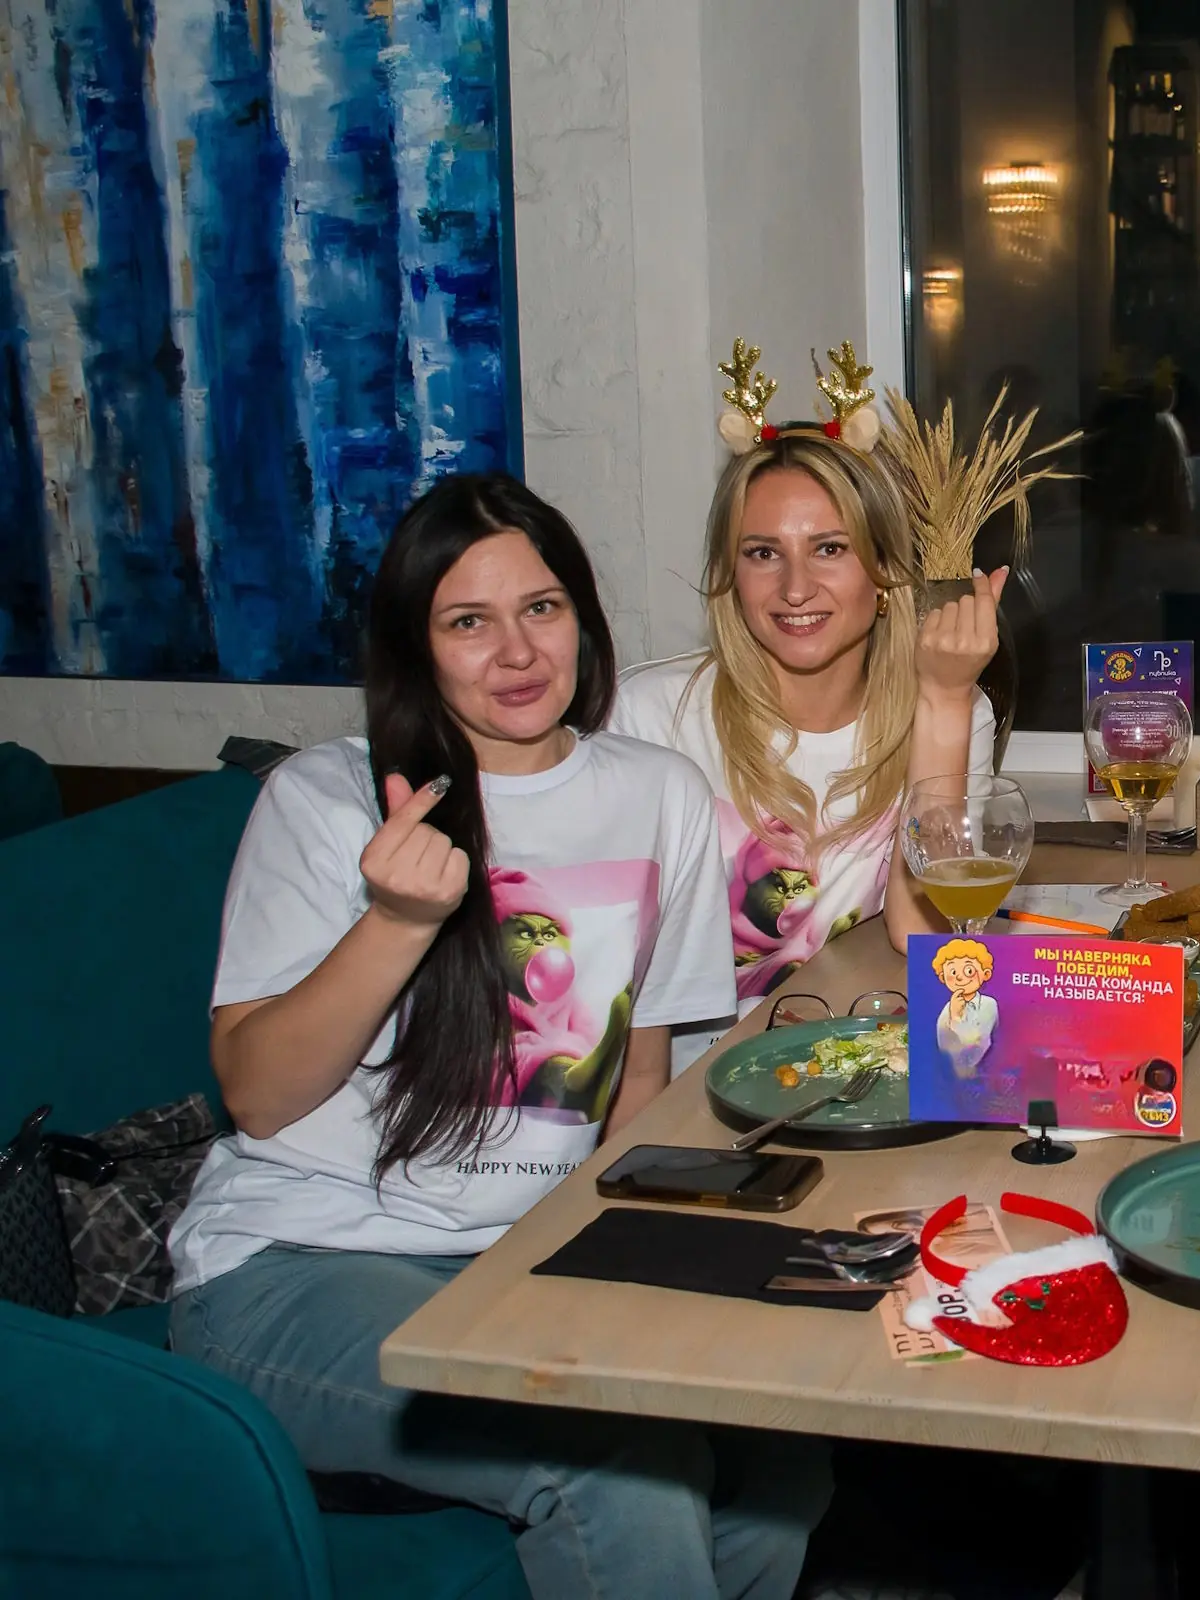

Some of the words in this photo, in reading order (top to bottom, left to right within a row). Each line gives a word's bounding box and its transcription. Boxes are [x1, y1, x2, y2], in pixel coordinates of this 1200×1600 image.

[1109, 670, 1133, 681] КВИЗ
[1034, 948, 1060, 960] МЫ
[1062, 949, 1151, 966] НАВЕРНЯКА
[1056, 962, 1133, 980] ПОБЕДИМ,
[1012, 973, 1050, 987] ВЕДЬ
[1053, 976, 1098, 988] НАША
[1101, 977, 1174, 994] КОМАНДА
[1044, 989, 1145, 1003] НАЗЫВАЕТСЯ:
[457, 1161, 512, 1174] HAPPY
[516, 1162, 554, 1175] NEW
